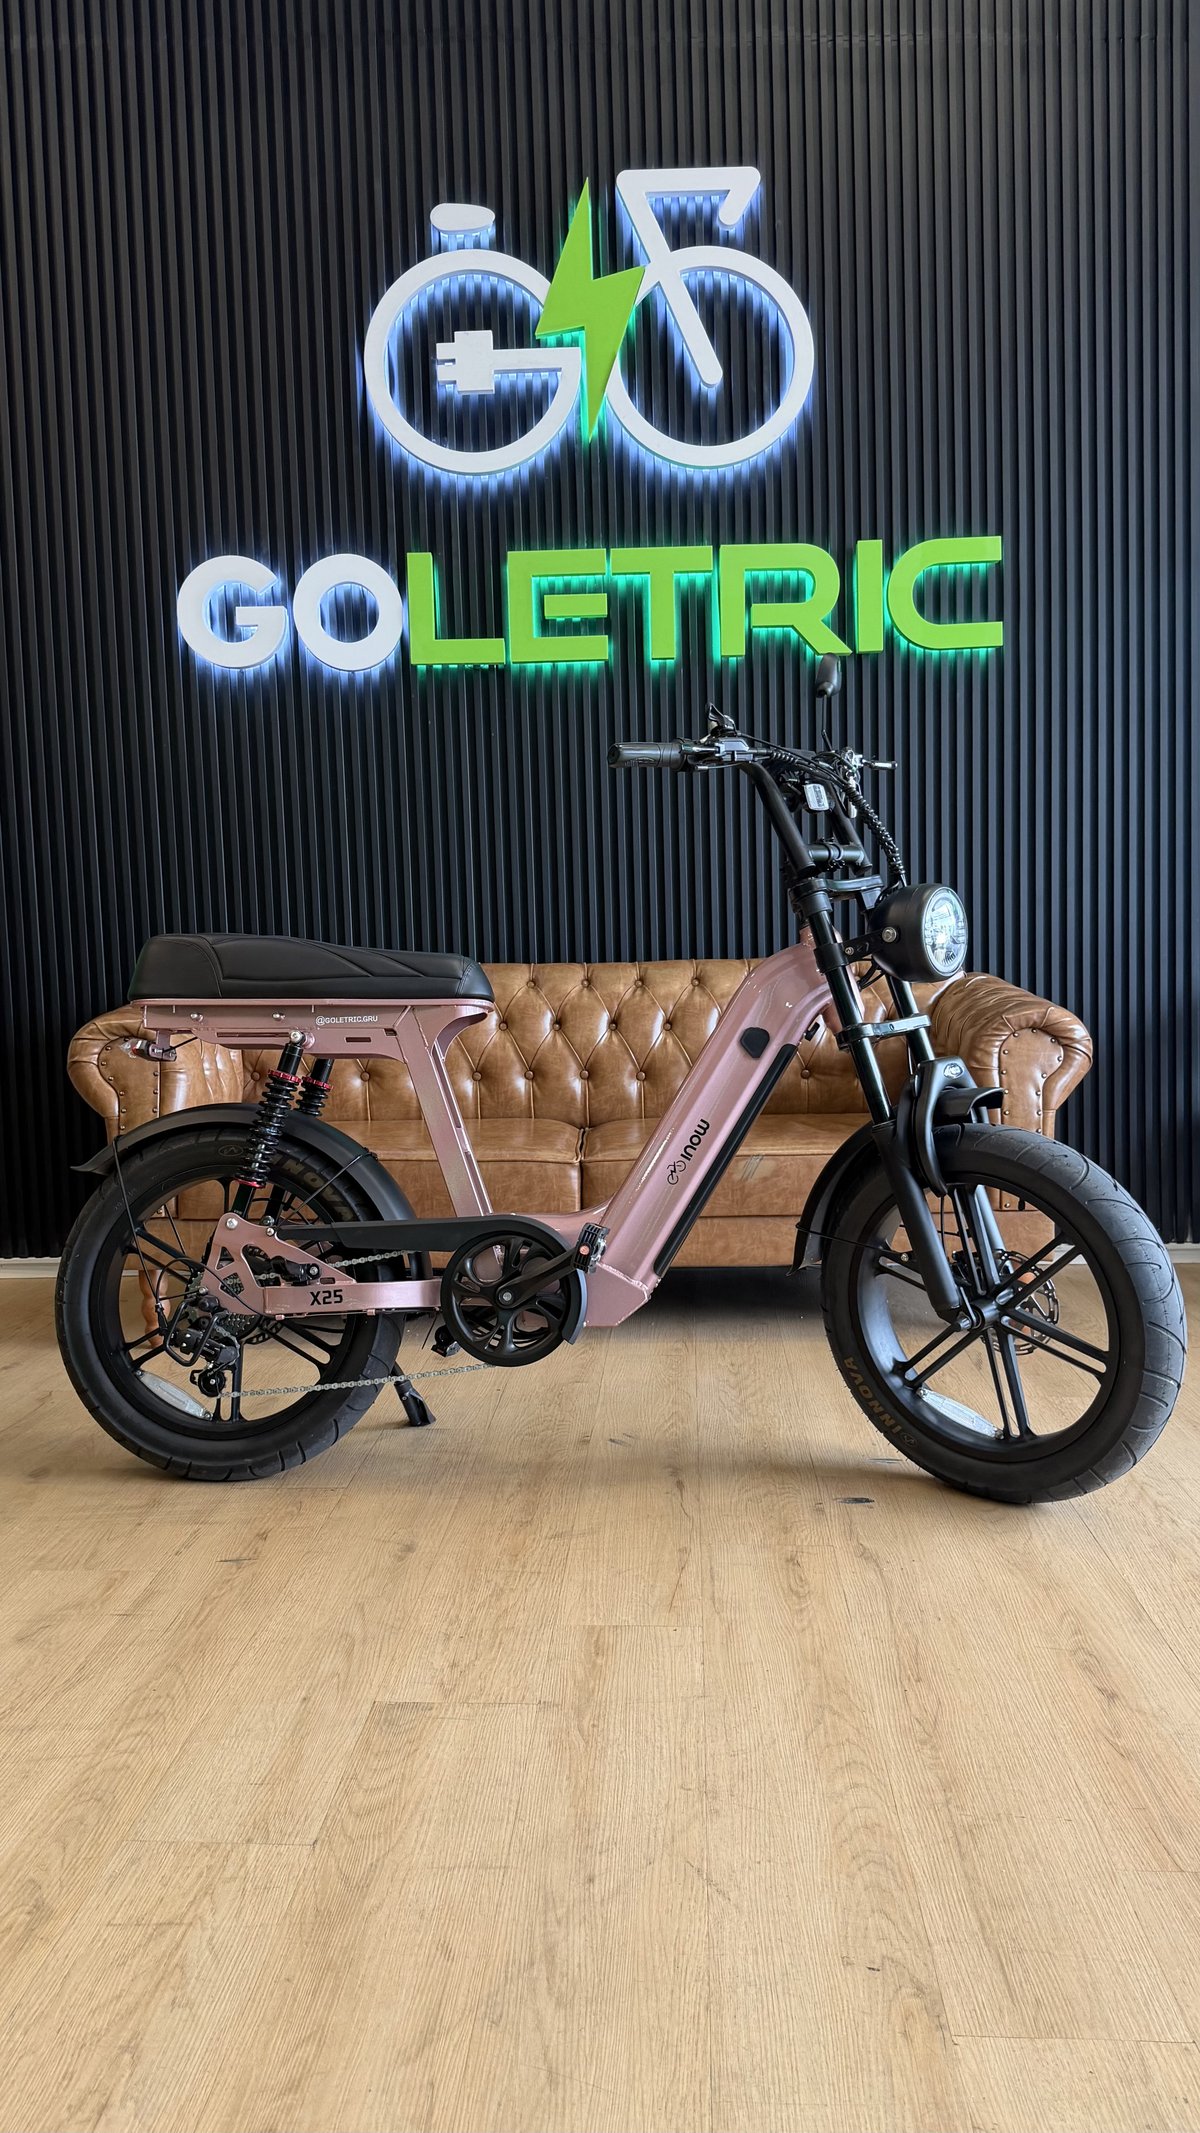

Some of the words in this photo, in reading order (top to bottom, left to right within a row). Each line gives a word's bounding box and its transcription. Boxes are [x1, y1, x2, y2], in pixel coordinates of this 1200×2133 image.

[177, 535, 1003, 671] GOLETRIC
[315, 1015, 378, 1026] @GOLETRIC.GRU
[310, 1289, 344, 1306] X25
[843, 1357, 902, 1434] INNOVA
